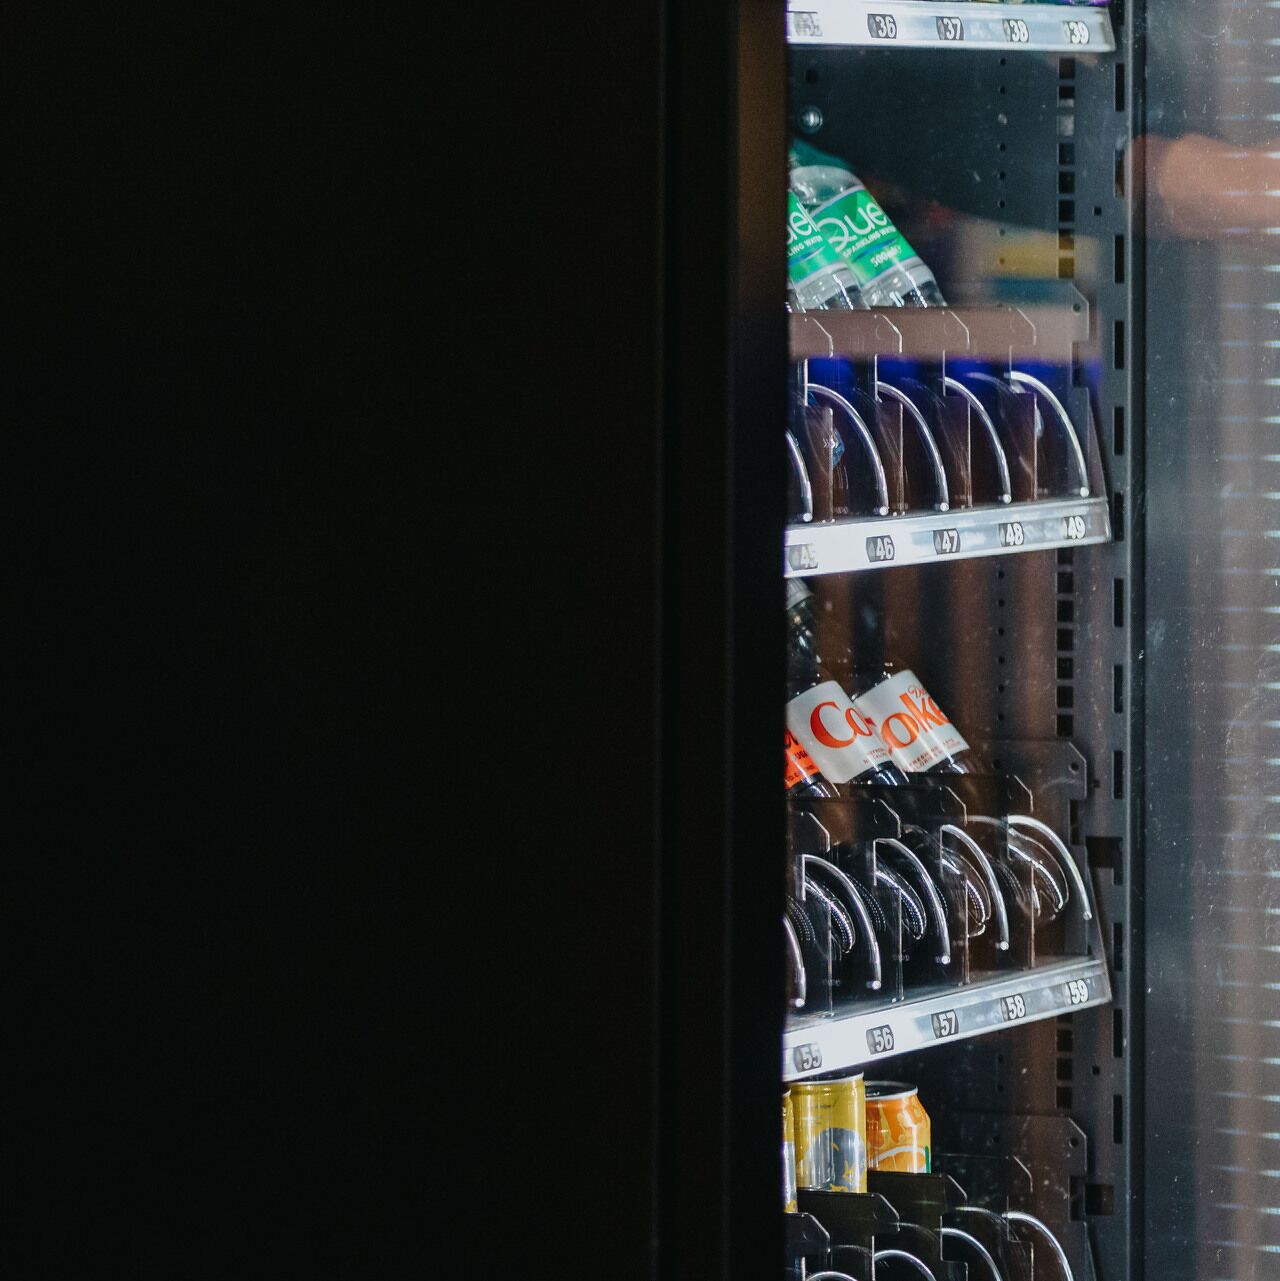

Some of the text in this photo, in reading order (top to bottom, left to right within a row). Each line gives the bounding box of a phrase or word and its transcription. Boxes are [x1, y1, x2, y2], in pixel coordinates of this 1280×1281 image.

[876, 15, 1090, 44] 36 37 38 39
[875, 537, 895, 561] 46
[941, 529, 959, 553] 47
[1005, 522, 1025, 547] 48
[1067, 515, 1087, 540] 49
[801, 978, 1090, 1070] 55 56 57 58 59
